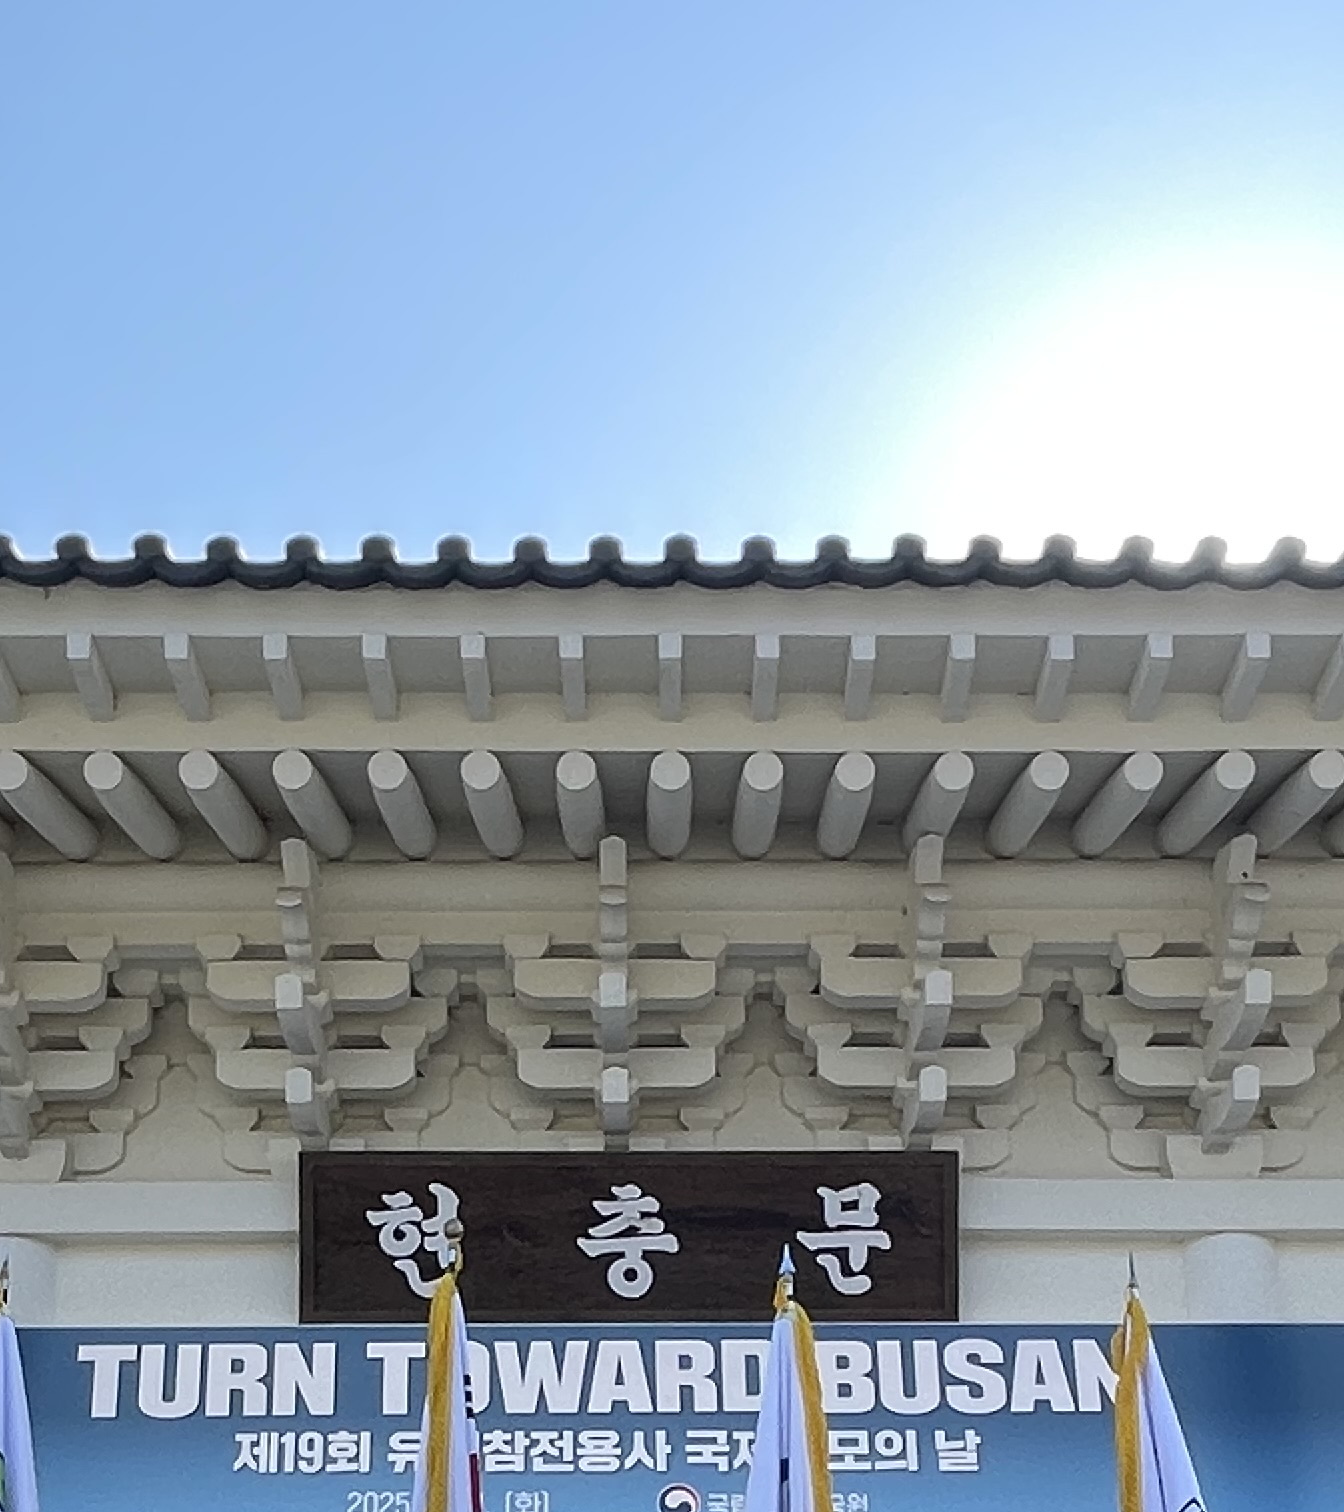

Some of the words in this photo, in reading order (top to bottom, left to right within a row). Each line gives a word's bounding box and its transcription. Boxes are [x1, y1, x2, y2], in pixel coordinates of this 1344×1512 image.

[365, 1182, 891, 1298] 현충문
[77, 1341, 336, 1419] TURN
[814, 1338, 1119, 1415] BUSAN
[233, 1430, 371, 1474] 제19회
[387, 1429, 672, 1473] 유참전용사
[684, 1428, 919, 1472] 국모의
[934, 1428, 982, 1472] 날
